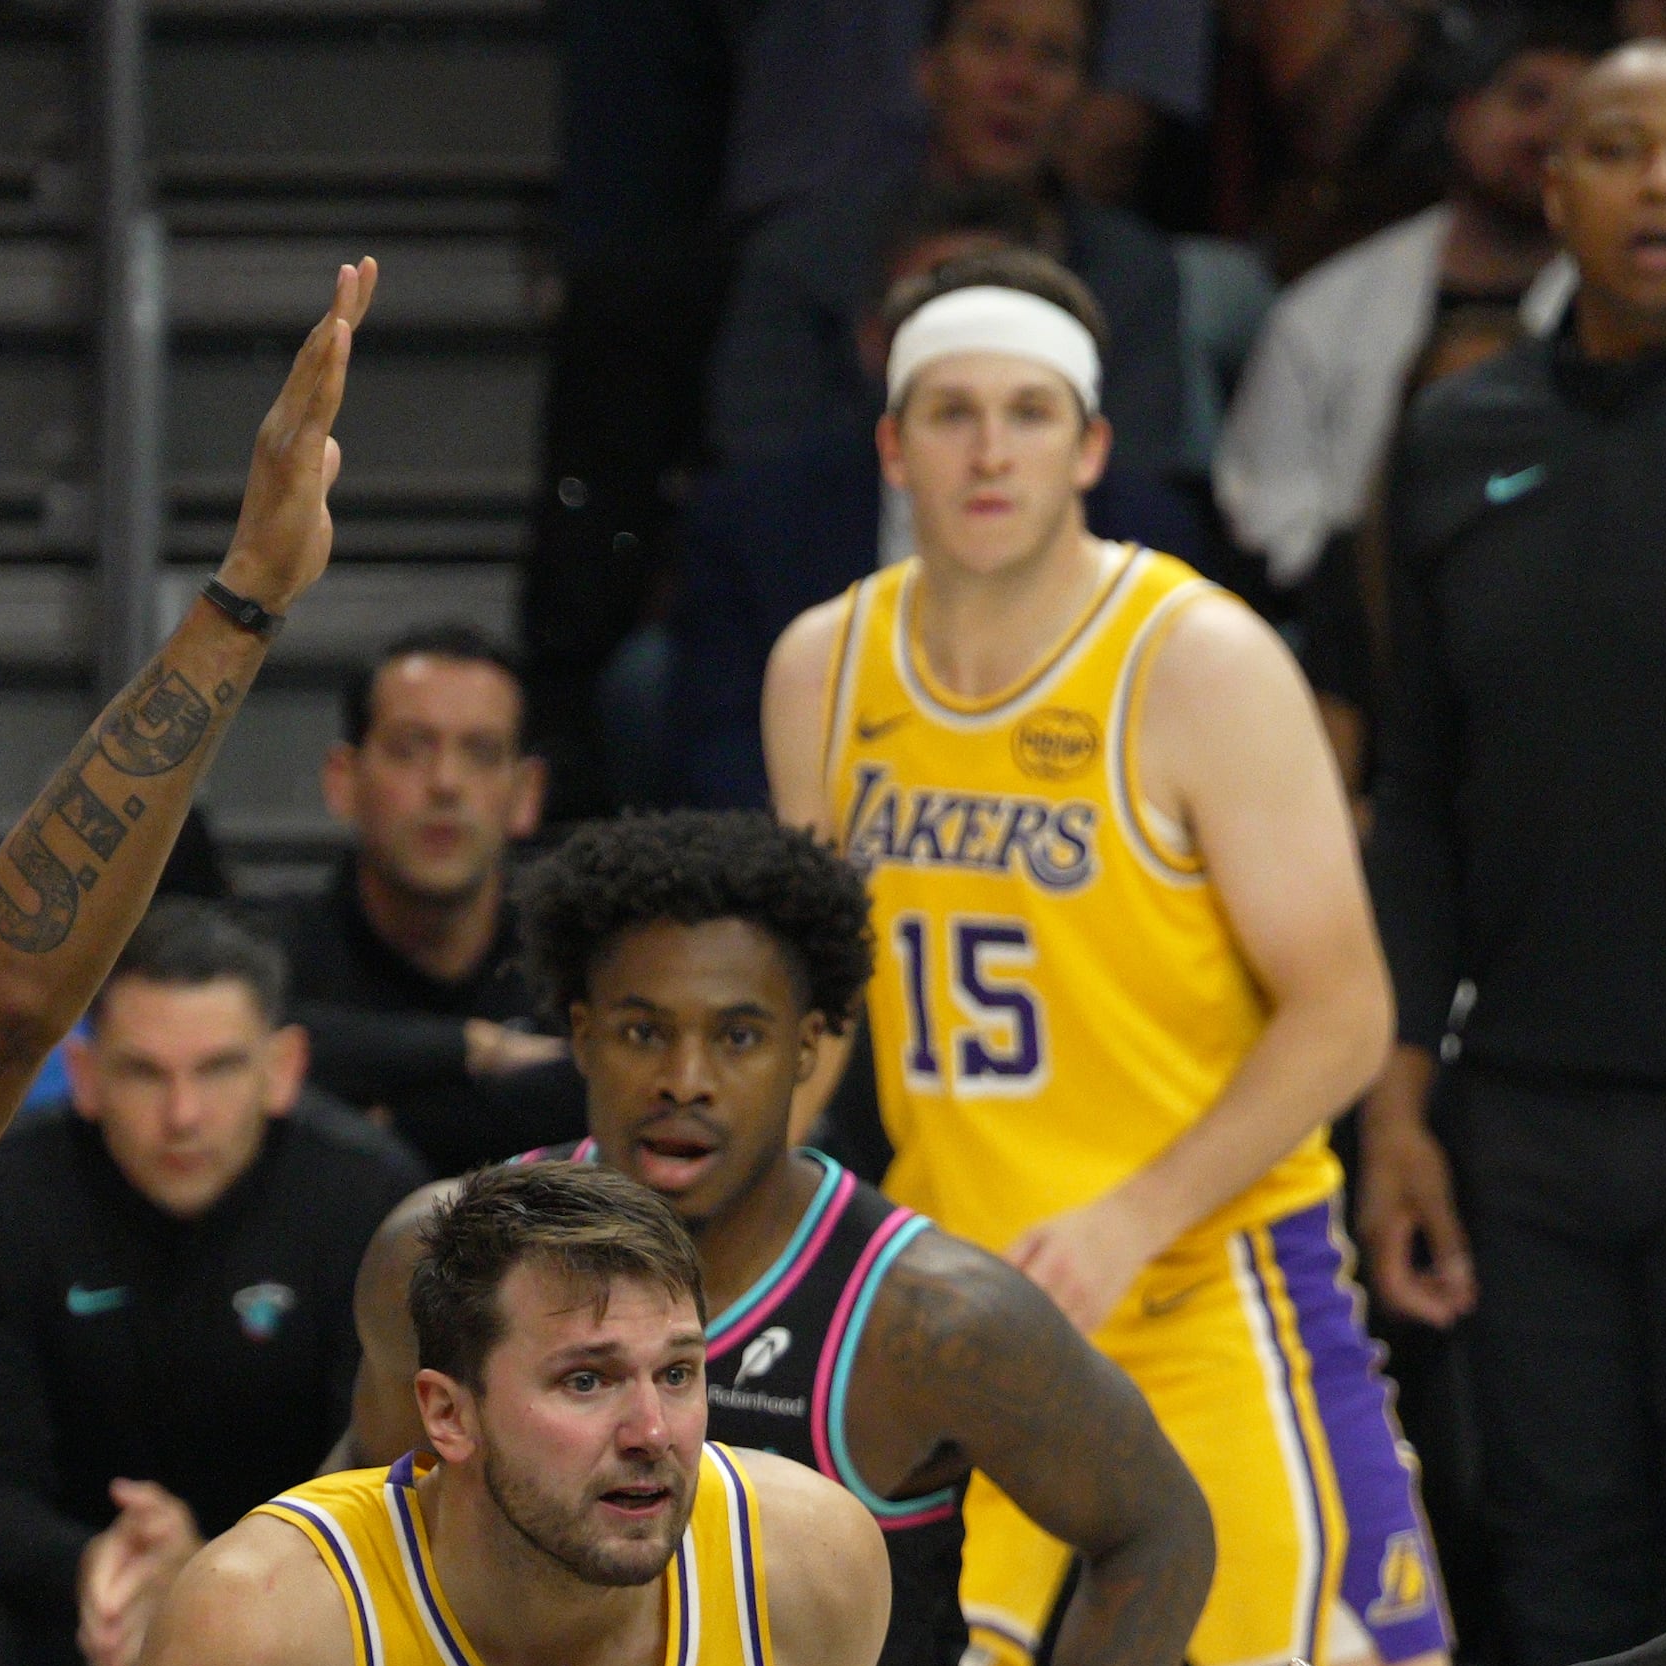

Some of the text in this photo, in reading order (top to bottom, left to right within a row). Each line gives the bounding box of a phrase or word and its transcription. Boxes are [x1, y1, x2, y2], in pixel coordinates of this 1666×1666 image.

[845, 763, 1103, 893] LAKERS
[893, 911, 1053, 1098] 15
[708, 1384, 805, 1418] Robinhood
